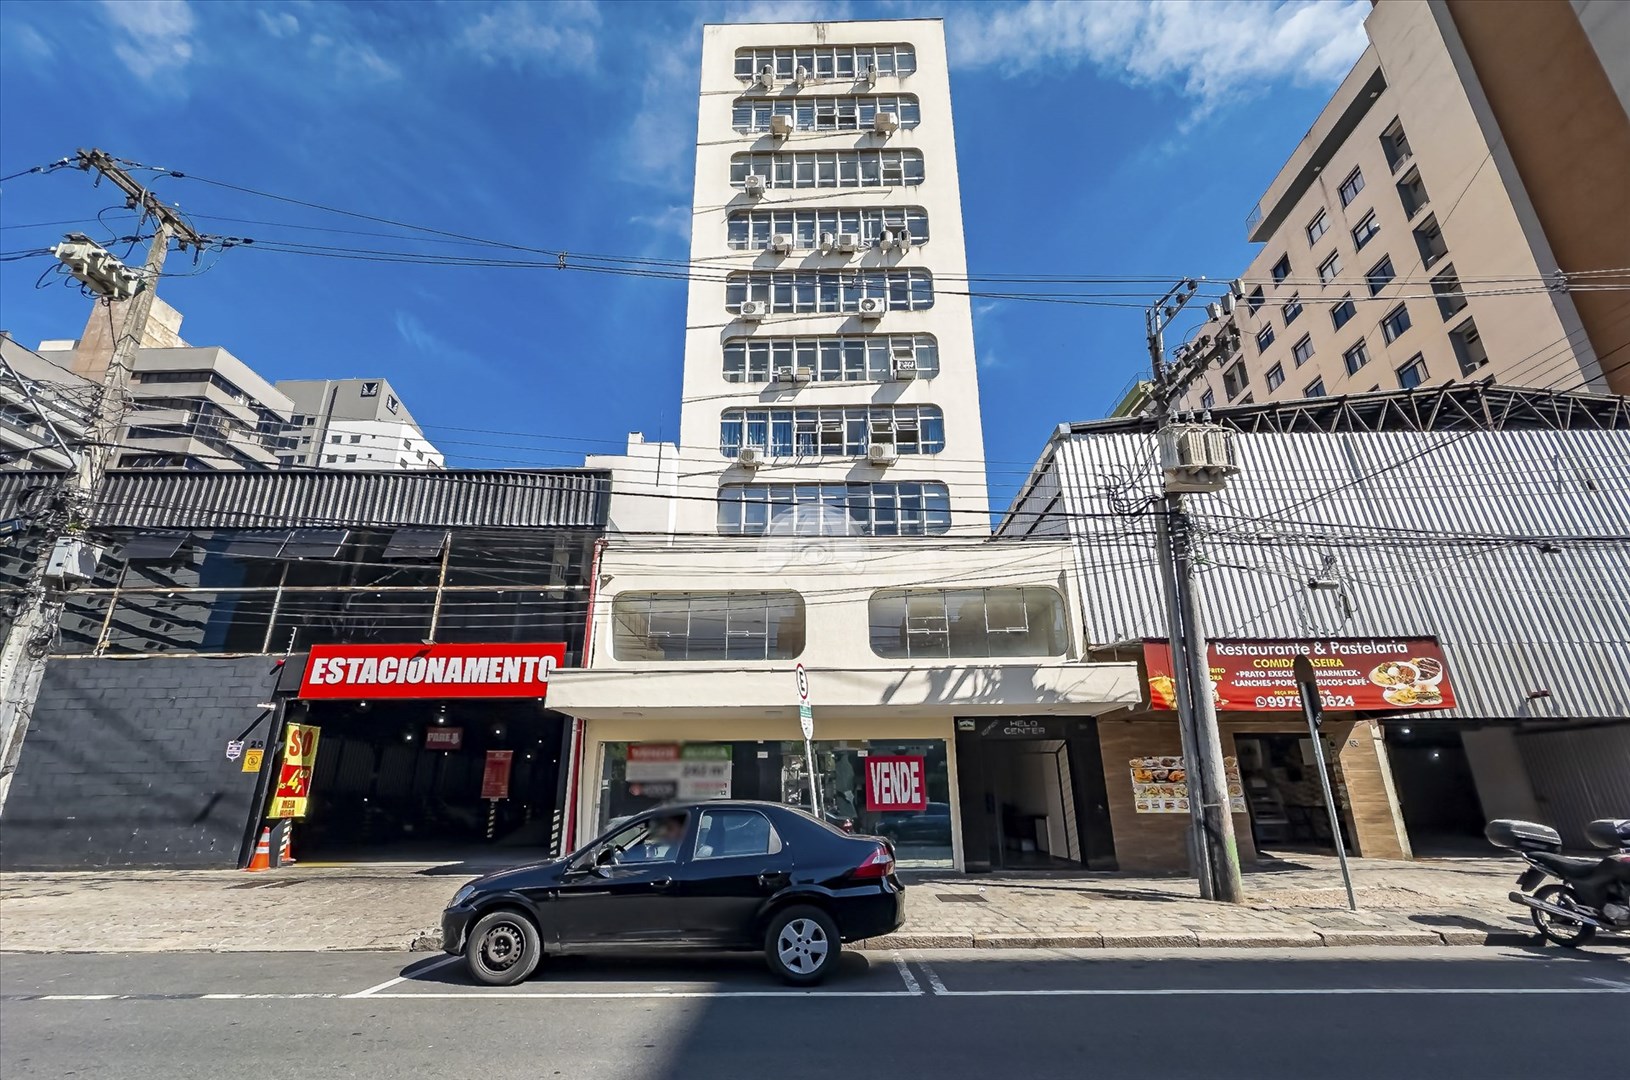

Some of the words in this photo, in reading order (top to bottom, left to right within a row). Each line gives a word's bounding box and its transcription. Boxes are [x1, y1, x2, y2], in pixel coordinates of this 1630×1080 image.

[1215, 642, 1310, 655] Restaurante
[1314, 641, 1326, 655] &
[1330, 640, 1408, 655] Pastelaria
[1309, 658, 1344, 667] ASEIRA
[309, 655, 556, 684] ESTACIONAMENTO
[1240, 670, 1266, 678] PRATO
[1316, 669, 1358, 677] MARMITEX
[1235, 679, 1271, 687] LANCHES
[1276, 679, 1298, 688] PORÇ
[1347, 677, 1367, 686] CAFÉ
[1003, 727, 1046, 735] CENTER
[870, 761, 921, 804] VENDE
